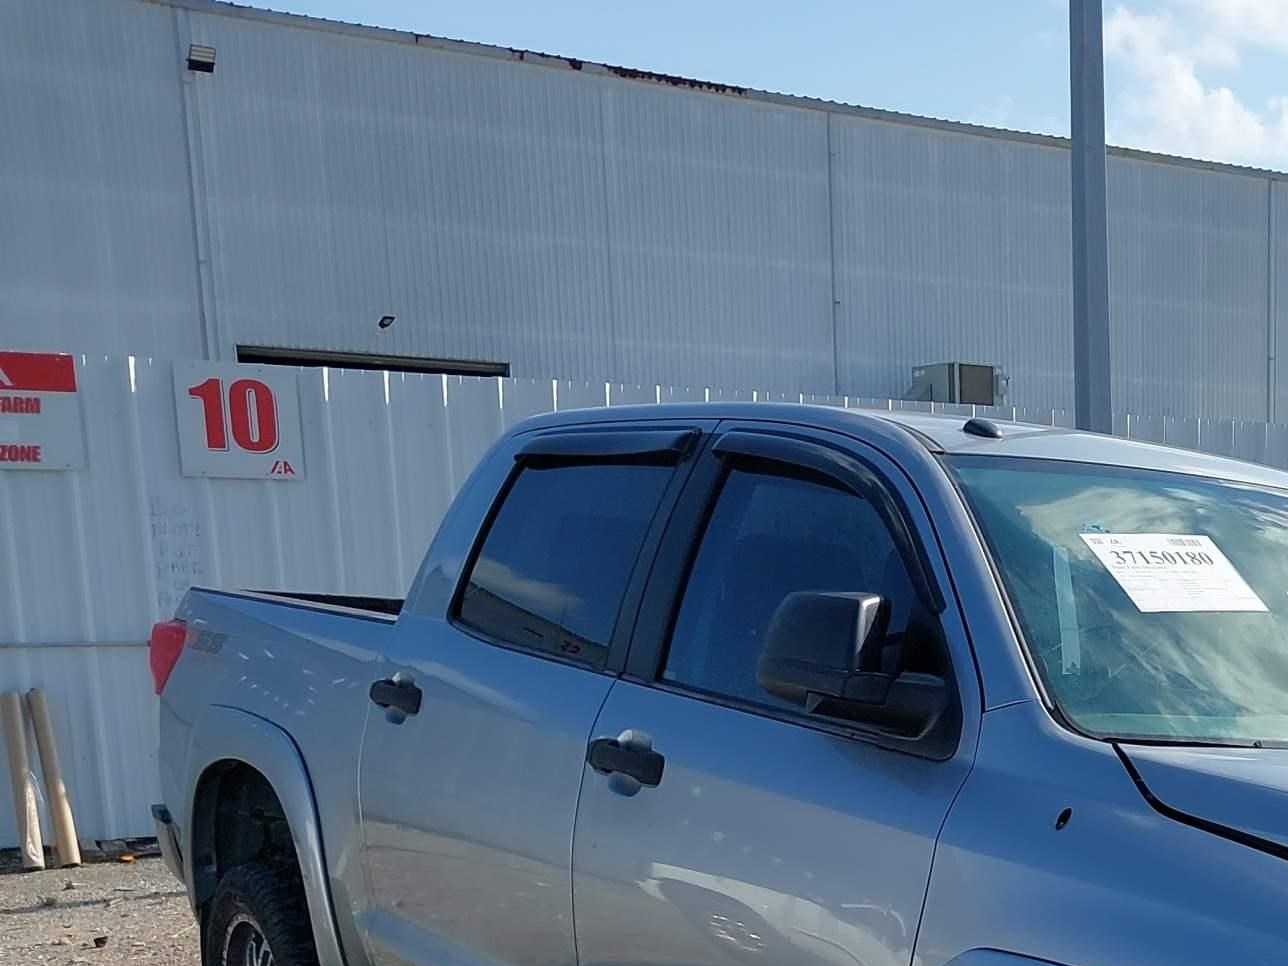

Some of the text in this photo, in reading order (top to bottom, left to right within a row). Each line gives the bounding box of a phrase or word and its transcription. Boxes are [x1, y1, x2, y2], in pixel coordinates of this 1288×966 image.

[0, 396, 41, 415] ARM
[187, 377, 280, 455] 10
[1109, 550, 1214, 566] 37150180
